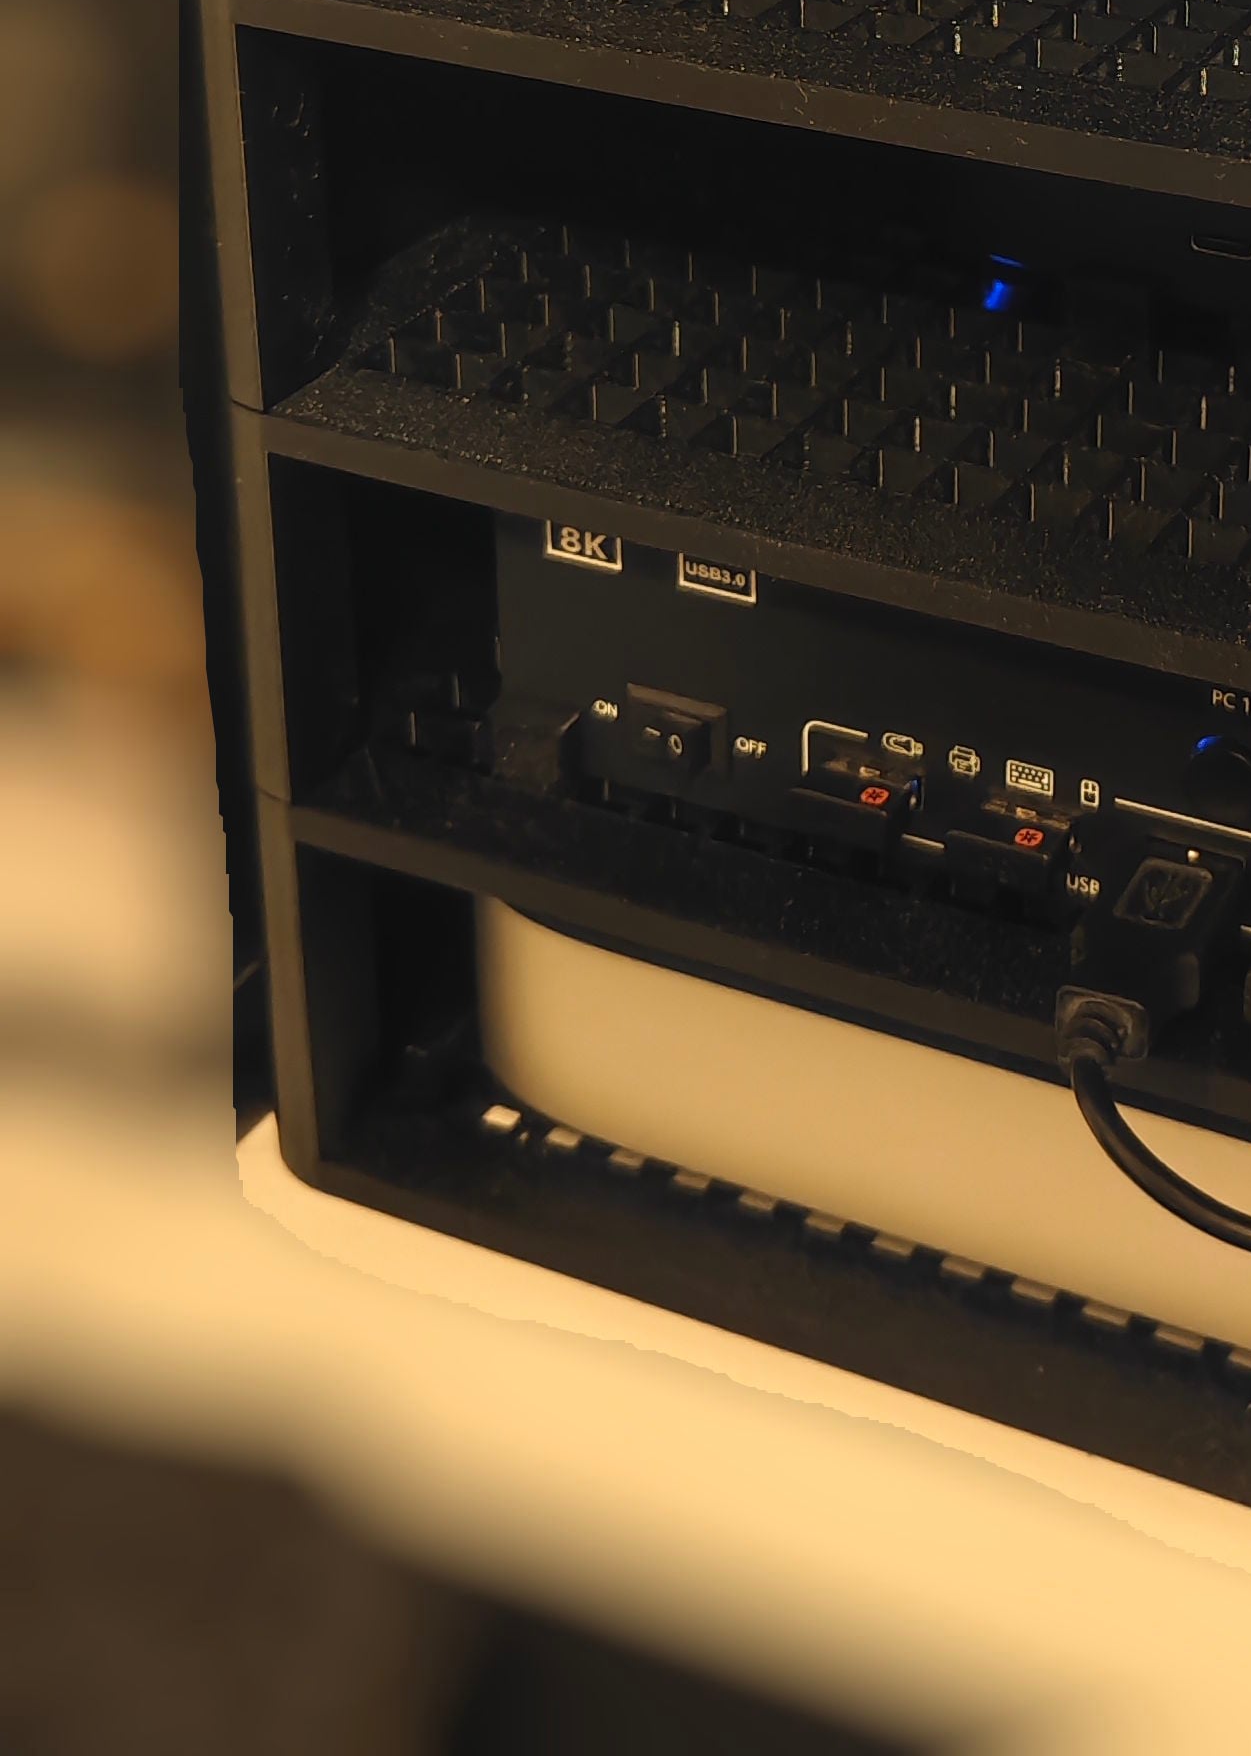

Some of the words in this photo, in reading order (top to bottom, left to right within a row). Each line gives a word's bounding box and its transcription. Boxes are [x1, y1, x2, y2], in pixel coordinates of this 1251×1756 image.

[559, 525, 609, 561] 8K
[684, 560, 747, 590] USB3.0
[592, 699, 618, 718] ON
[1211, 687, 1238, 711] PC
[1242, 695, 1251, 716] 1
[735, 736, 767, 759] OFF
[1065, 872, 1101, 897] USB
